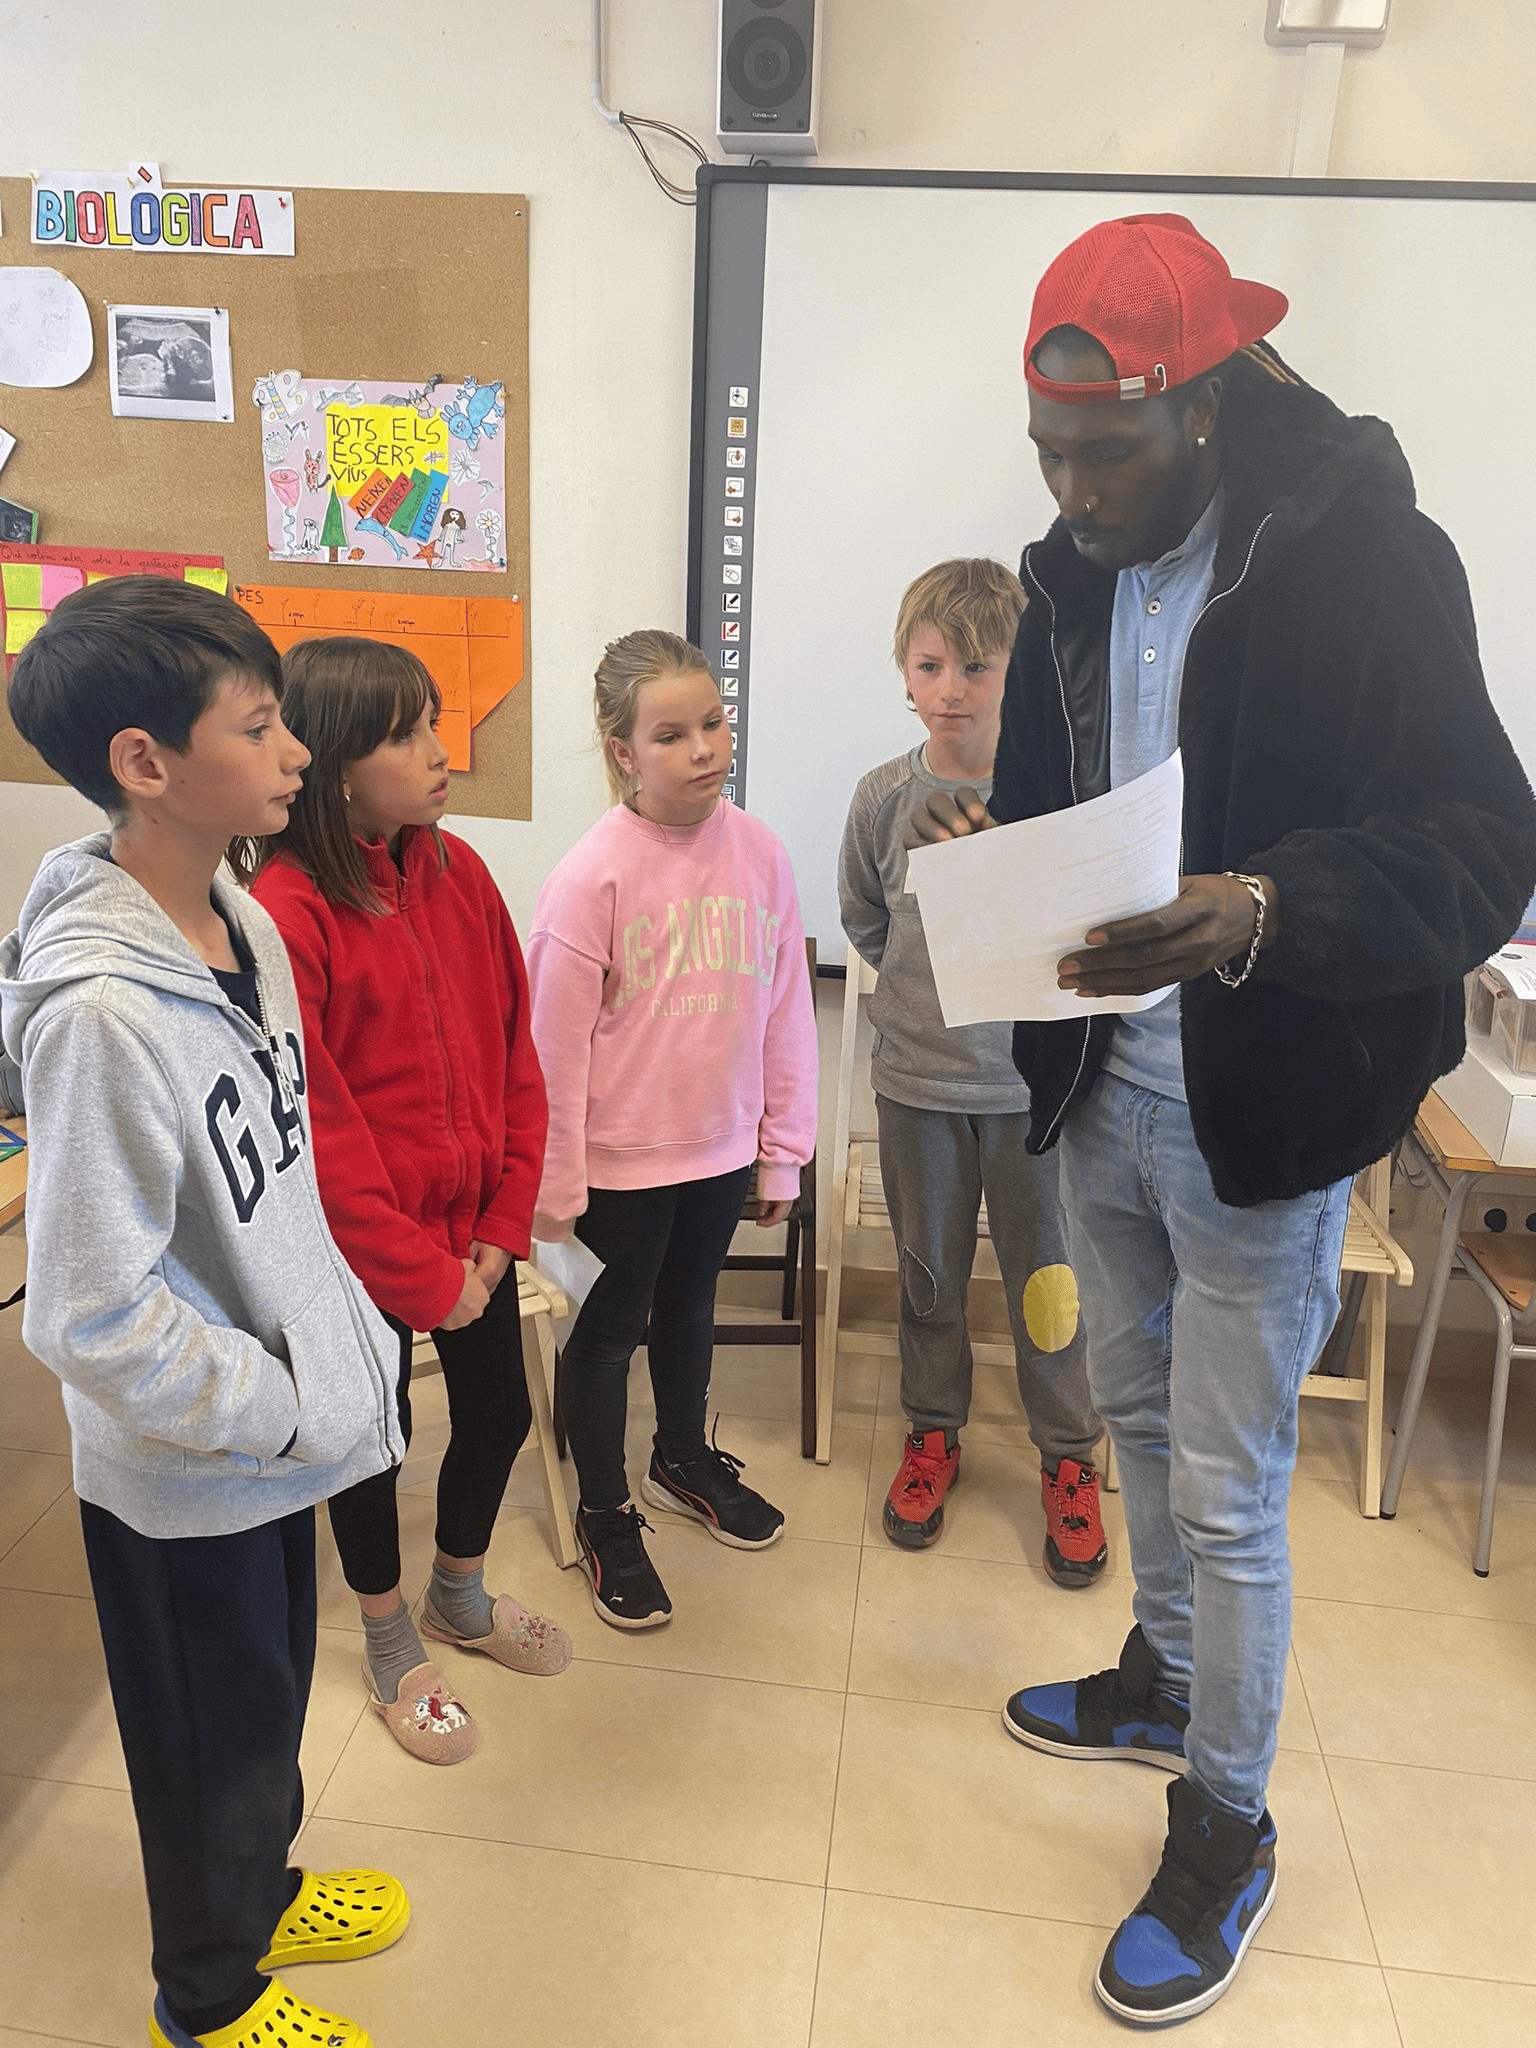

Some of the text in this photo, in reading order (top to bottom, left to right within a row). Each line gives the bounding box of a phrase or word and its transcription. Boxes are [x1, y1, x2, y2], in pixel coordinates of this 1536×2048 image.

[326, 413, 441, 444] TOTS ELS
[419, 487, 442, 535] MOREN
[238, 589, 264, 605] PES
